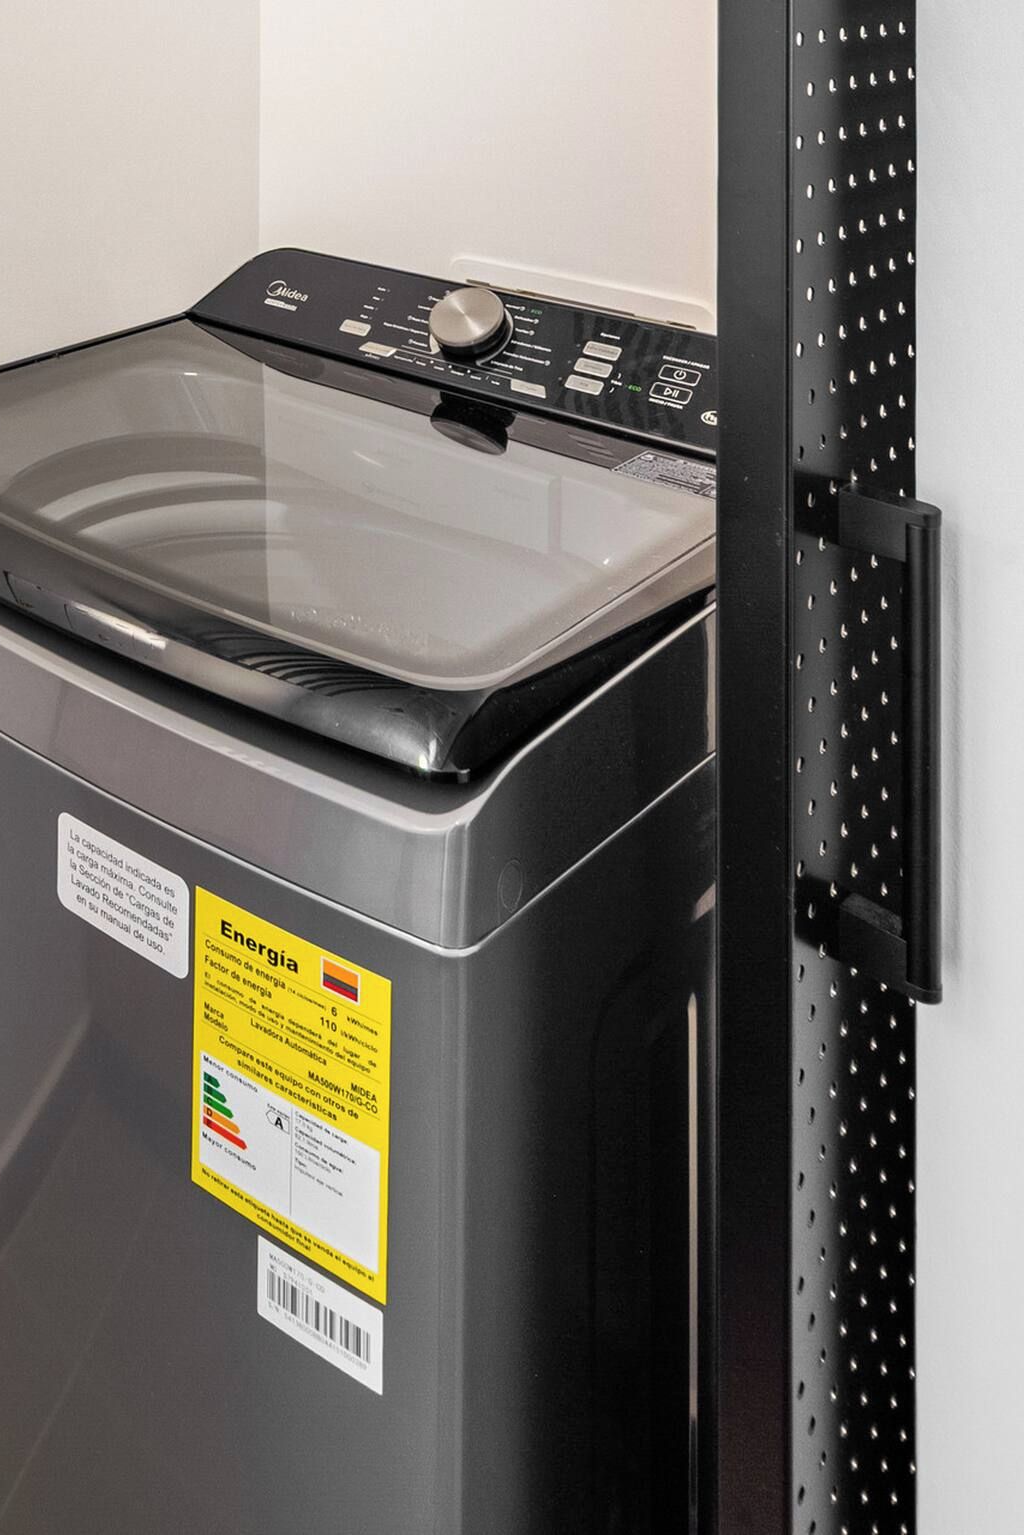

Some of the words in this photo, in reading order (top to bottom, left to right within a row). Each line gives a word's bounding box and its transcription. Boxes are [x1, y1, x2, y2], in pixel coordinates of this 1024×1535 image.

[266, 279, 308, 302] Midea
[67, 843, 75, 855] la
[76, 850, 99, 870] carga
[138, 885, 178, 915] Consulte
[69, 828, 80, 843] La
[81, 837, 124, 869] capacidad
[125, 861, 162, 891] indicada
[164, 886, 175, 898] es
[69, 858, 77, 871] la
[78, 864, 111, 892] Sección
[113, 884, 124, 899] de
[162, 913, 175, 929] de
[70, 874, 101, 901] Lavado
[76, 893, 87, 908] en
[88, 902, 99, 914] su
[100, 908, 132, 934] manual
[133, 927, 144, 942] de
[221, 920, 298, 973] Energía
[205, 939, 242, 966] Consumo
[244, 962, 253, 972] de
[331, 1007, 337, 1017] 6
[205, 955, 229, 974] Factor
[231, 971, 240, 982] de
[320, 1017, 337, 1032] 110
[204, 1002, 224, 1019] Marca
[251, 1019, 283, 1042] Lavadora
[219, 1036, 254, 1061] Compare
[256, 1059, 273, 1072] este
[275, 1069, 303, 1089] equipo
[305, 1086, 321, 1099] con
[323, 1096, 345, 1112] otros
[348, 1110, 358, 1119] de
[237, 1060, 273, 1085] similares
[351, 1083, 376, 1102] MIDEA
[206, 1106, 212, 1118] D
[275, 1117, 283, 1130] A
